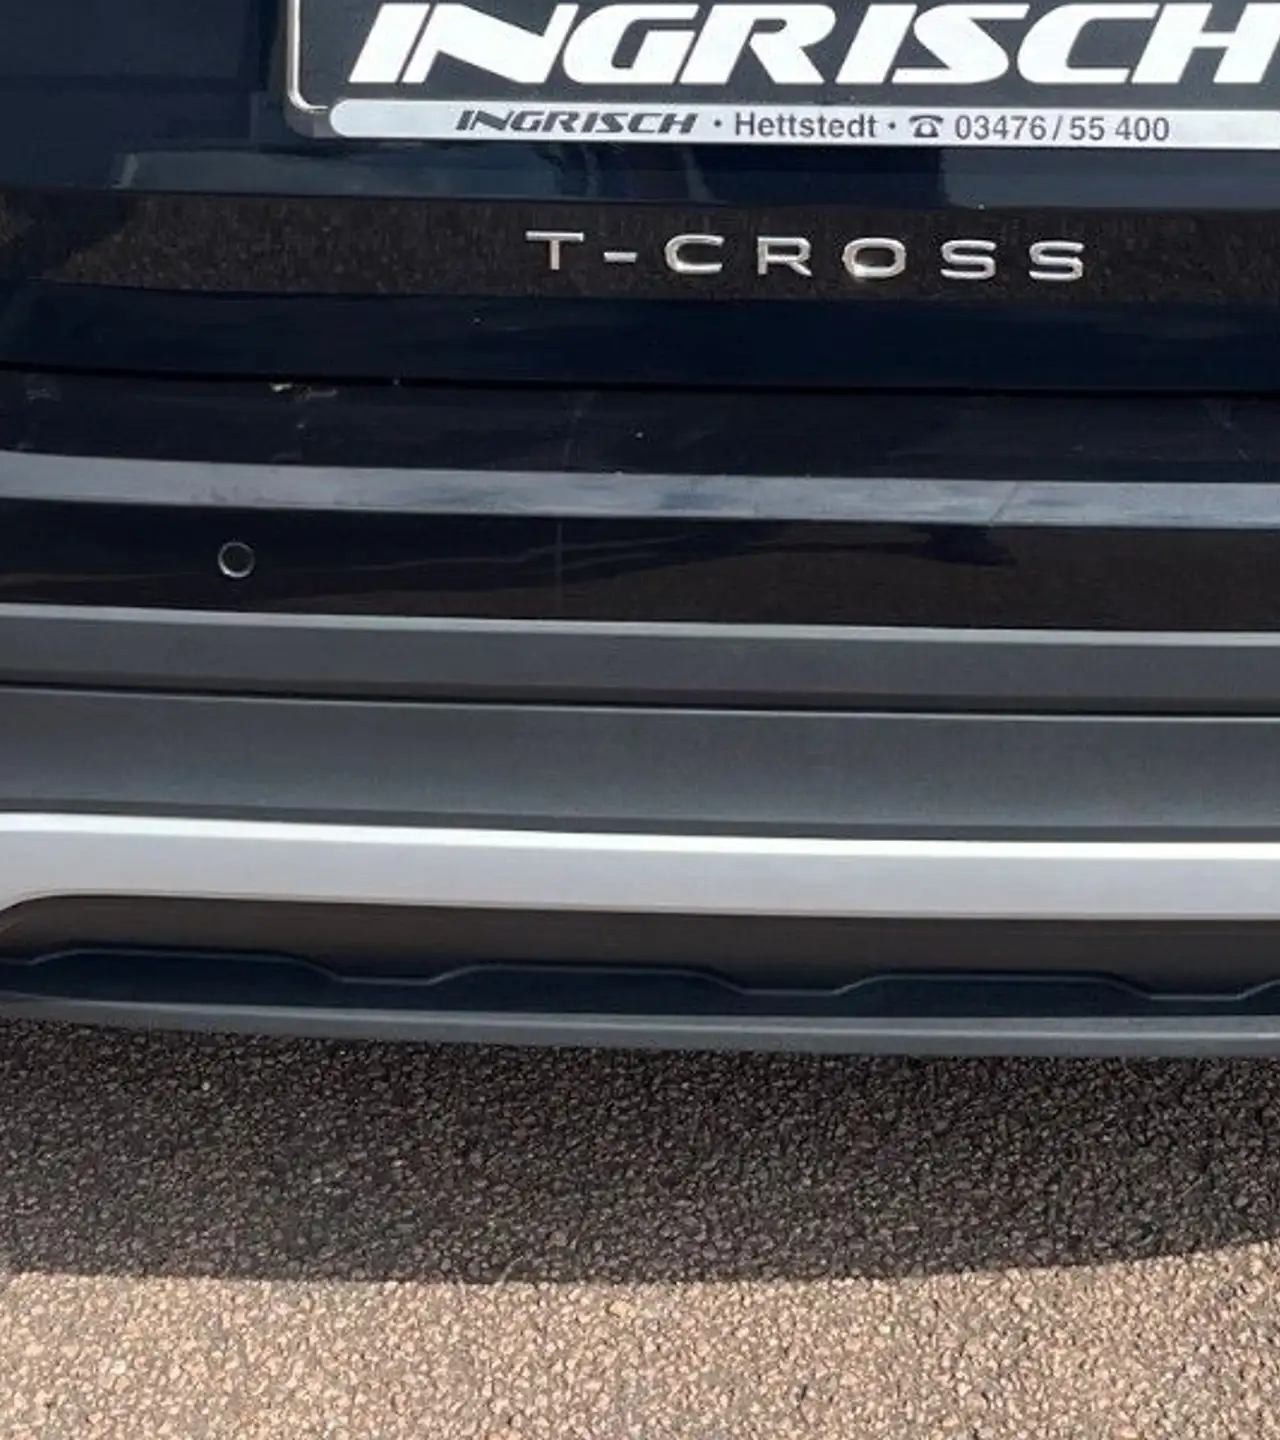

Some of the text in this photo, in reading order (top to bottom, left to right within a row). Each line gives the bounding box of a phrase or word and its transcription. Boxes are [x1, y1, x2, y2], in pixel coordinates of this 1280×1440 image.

[455, 110, 698, 134] INGRISCH
[734, 111, 878, 138] Hettstedt
[1115, 117, 1170, 142] 400
[526, 231, 1084, 281] T-CROSS
